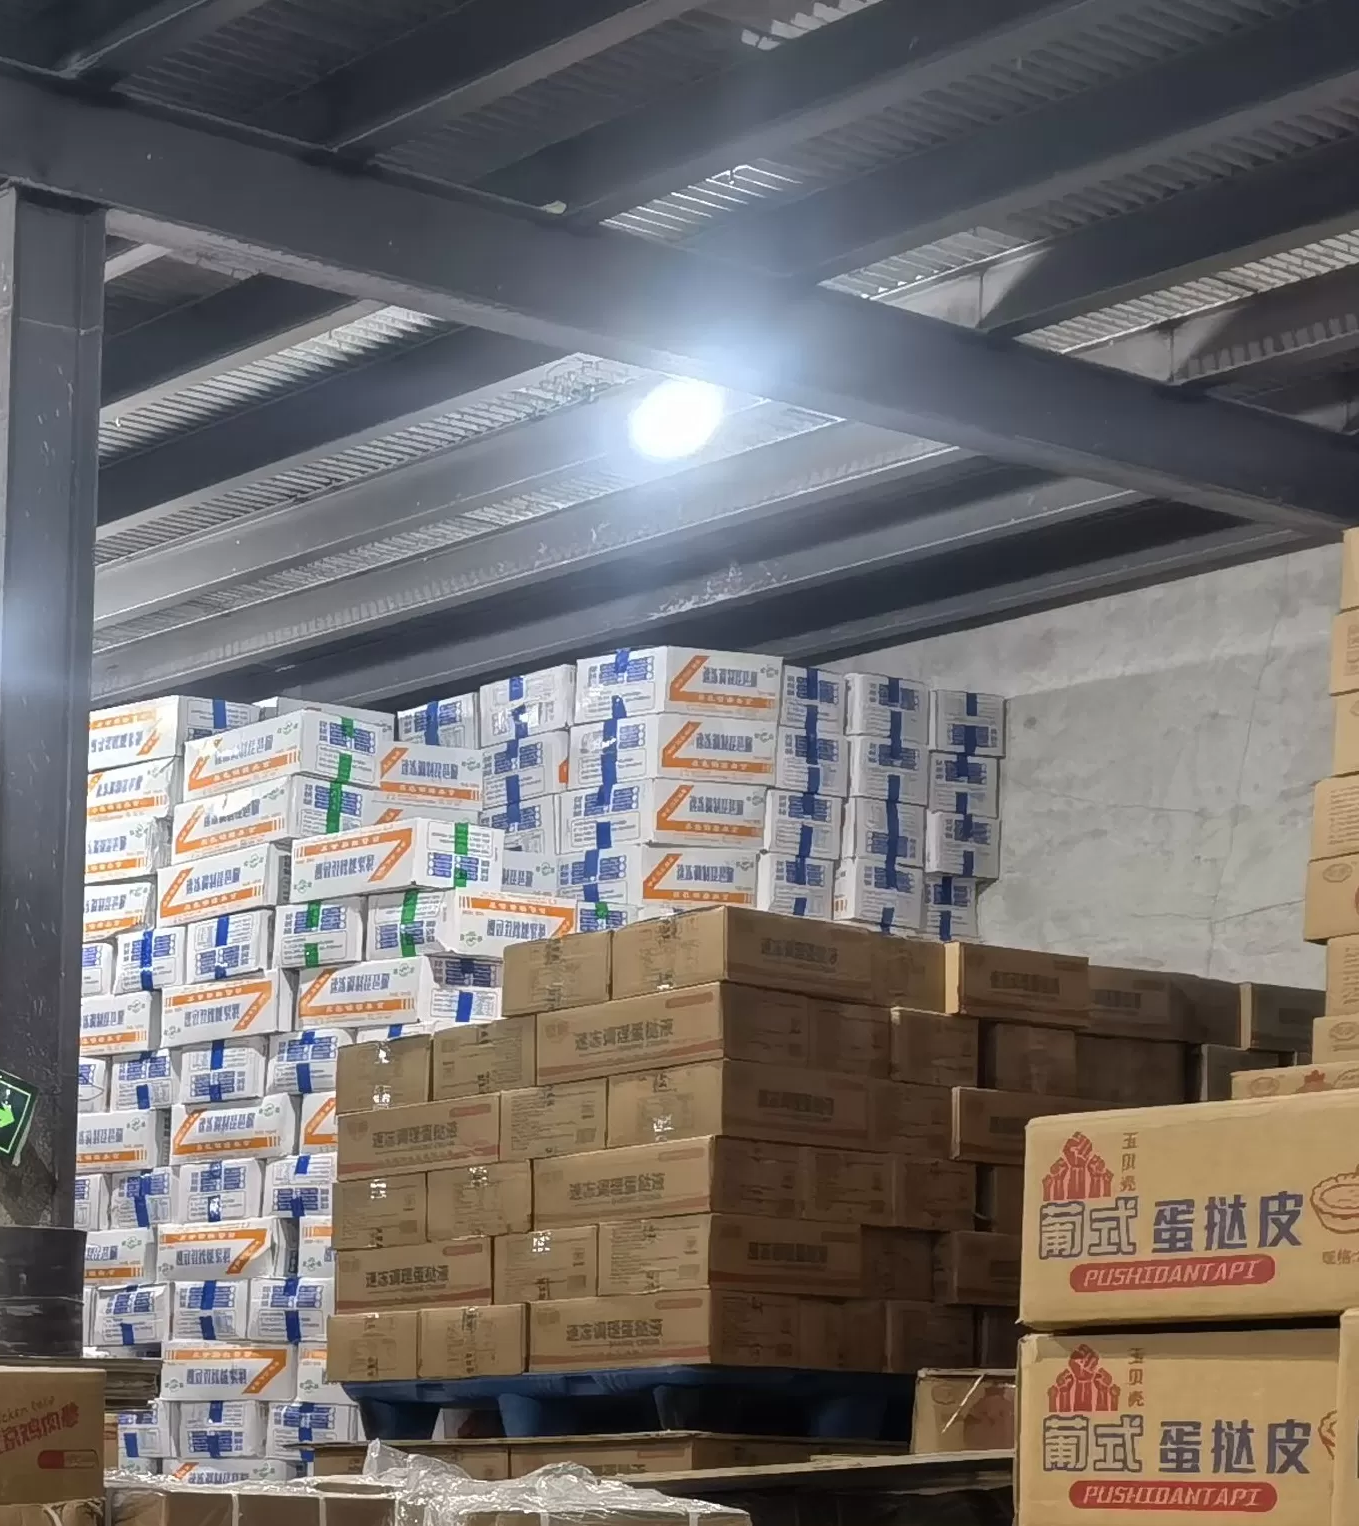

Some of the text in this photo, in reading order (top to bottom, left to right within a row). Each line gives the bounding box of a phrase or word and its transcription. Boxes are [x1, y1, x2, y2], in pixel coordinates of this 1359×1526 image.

[1038, 1191, 1305, 1260] 葡式蛋挞皮
[1083, 1257, 1261, 1289] PUSHIDANTAPI
[1042, 1414, 1312, 1476] 葡式蛋挞皮
[1083, 1484, 1262, 1509] PUSHIDANTAPI
